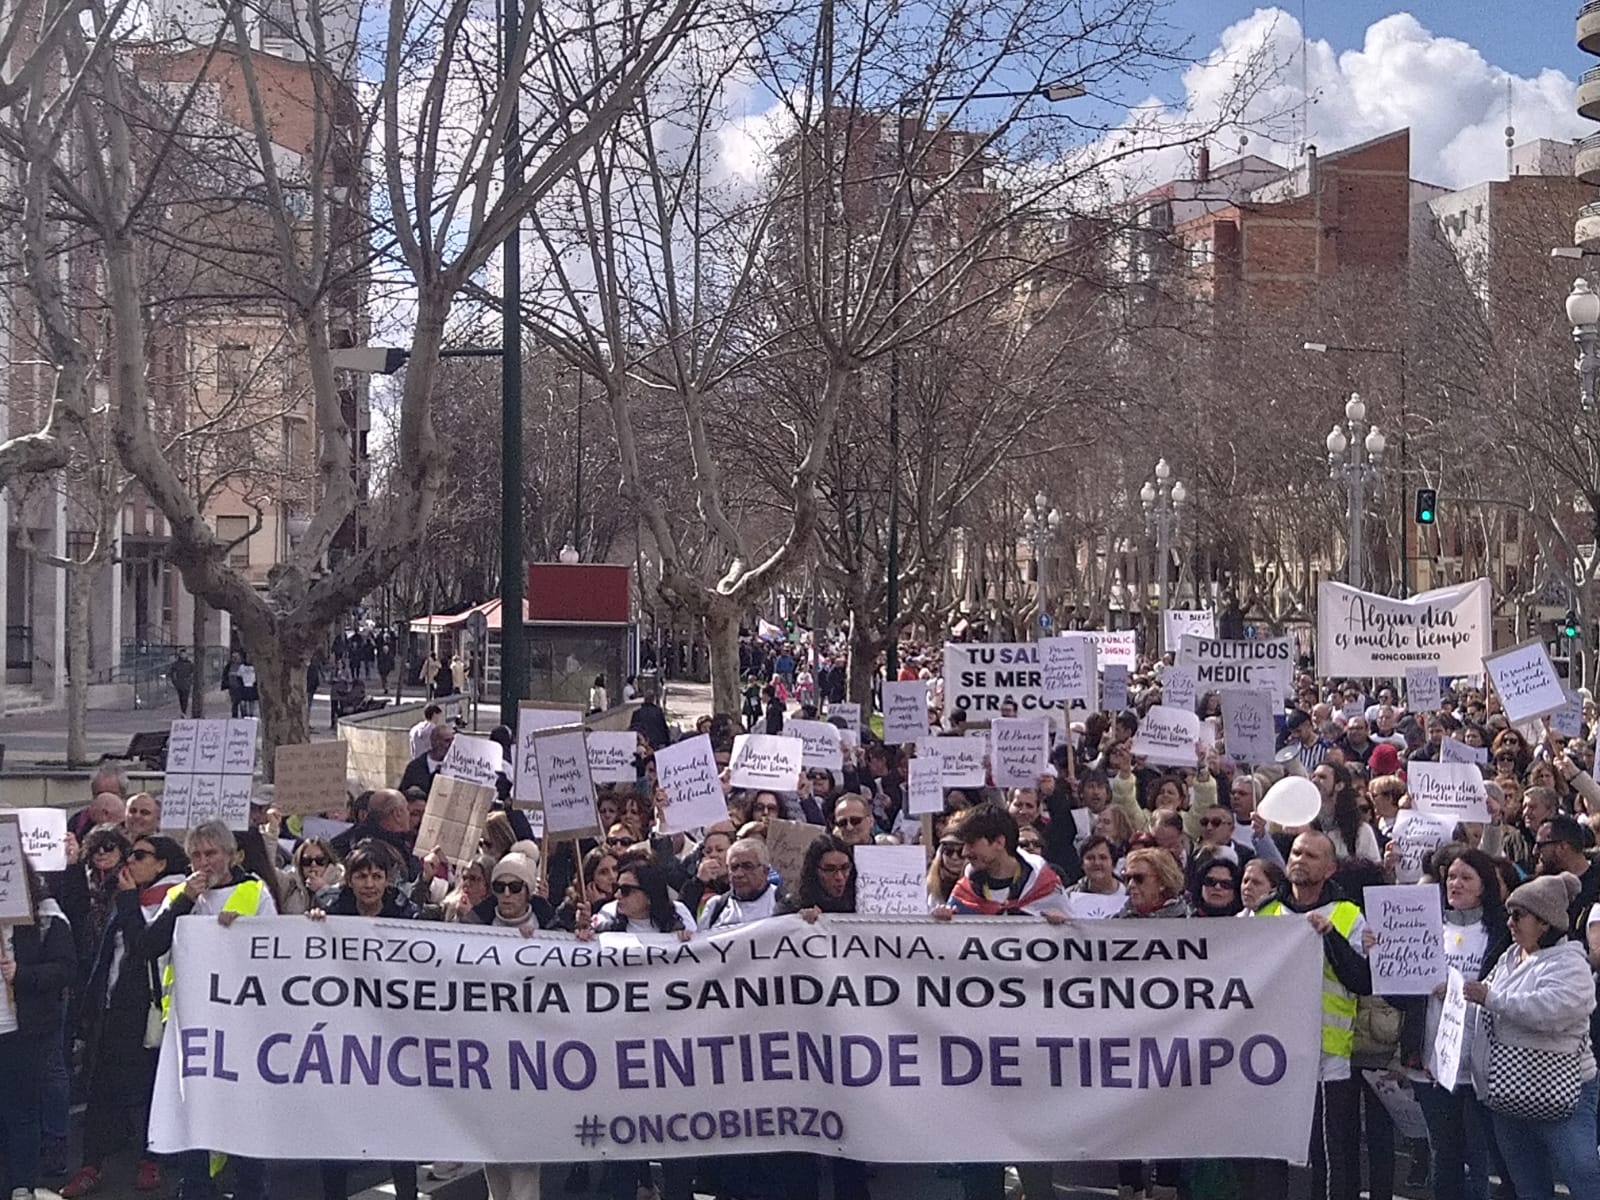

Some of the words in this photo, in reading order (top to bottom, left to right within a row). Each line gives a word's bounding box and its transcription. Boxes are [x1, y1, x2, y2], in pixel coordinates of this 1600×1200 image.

[1335, 632, 1350, 650] es
[1354, 627, 1410, 649] mucho
[967, 649, 994, 664] TU
[1001, 648, 1040, 664] SAL
[961, 672, 986, 687] SE
[995, 671, 1041, 688] MER
[1197, 661, 1277, 683] MÉDIC
[673, 754, 709, 775] sanidad
[1381, 900, 1403, 917] Por
[1422, 929, 1440, 946] los
[250, 936, 291, 960] EL
[304, 936, 442, 968] BIERZO,
[455, 943, 501, 966] LA
[514, 943, 699, 968] CABRERA
[711, 939, 735, 963] Y
[750, 934, 945, 961] LACIANA.
[958, 937, 1209, 962] AGONIZAN
[1375, 945, 1420, 968] pueblos
[1420, 946, 1437, 961] de
[1379, 961, 1395, 978] El
[1397, 961, 1438, 977] Bierzo
[209, 972, 266, 1007] LA
[281, 976, 571, 1014] CONSEJERÍA
[586, 980, 650, 1014] DE
[664, 974, 900, 1012] SANIDAD
[917, 975, 1026, 1009] NOS
[1044, 977, 1254, 1011] IGNORA
[181, 1027, 239, 1082] EL
[256, 1021, 492, 1090] CÁNCER
[509, 1038, 598, 1091] NO
[615, 1031, 920, 1090] ENTIENDE
[939, 1035, 1023, 1087] DE
[1036, 1033, 1288, 1090] TIEMPO
[575, 1106, 844, 1147] #ONCOBIERZO
